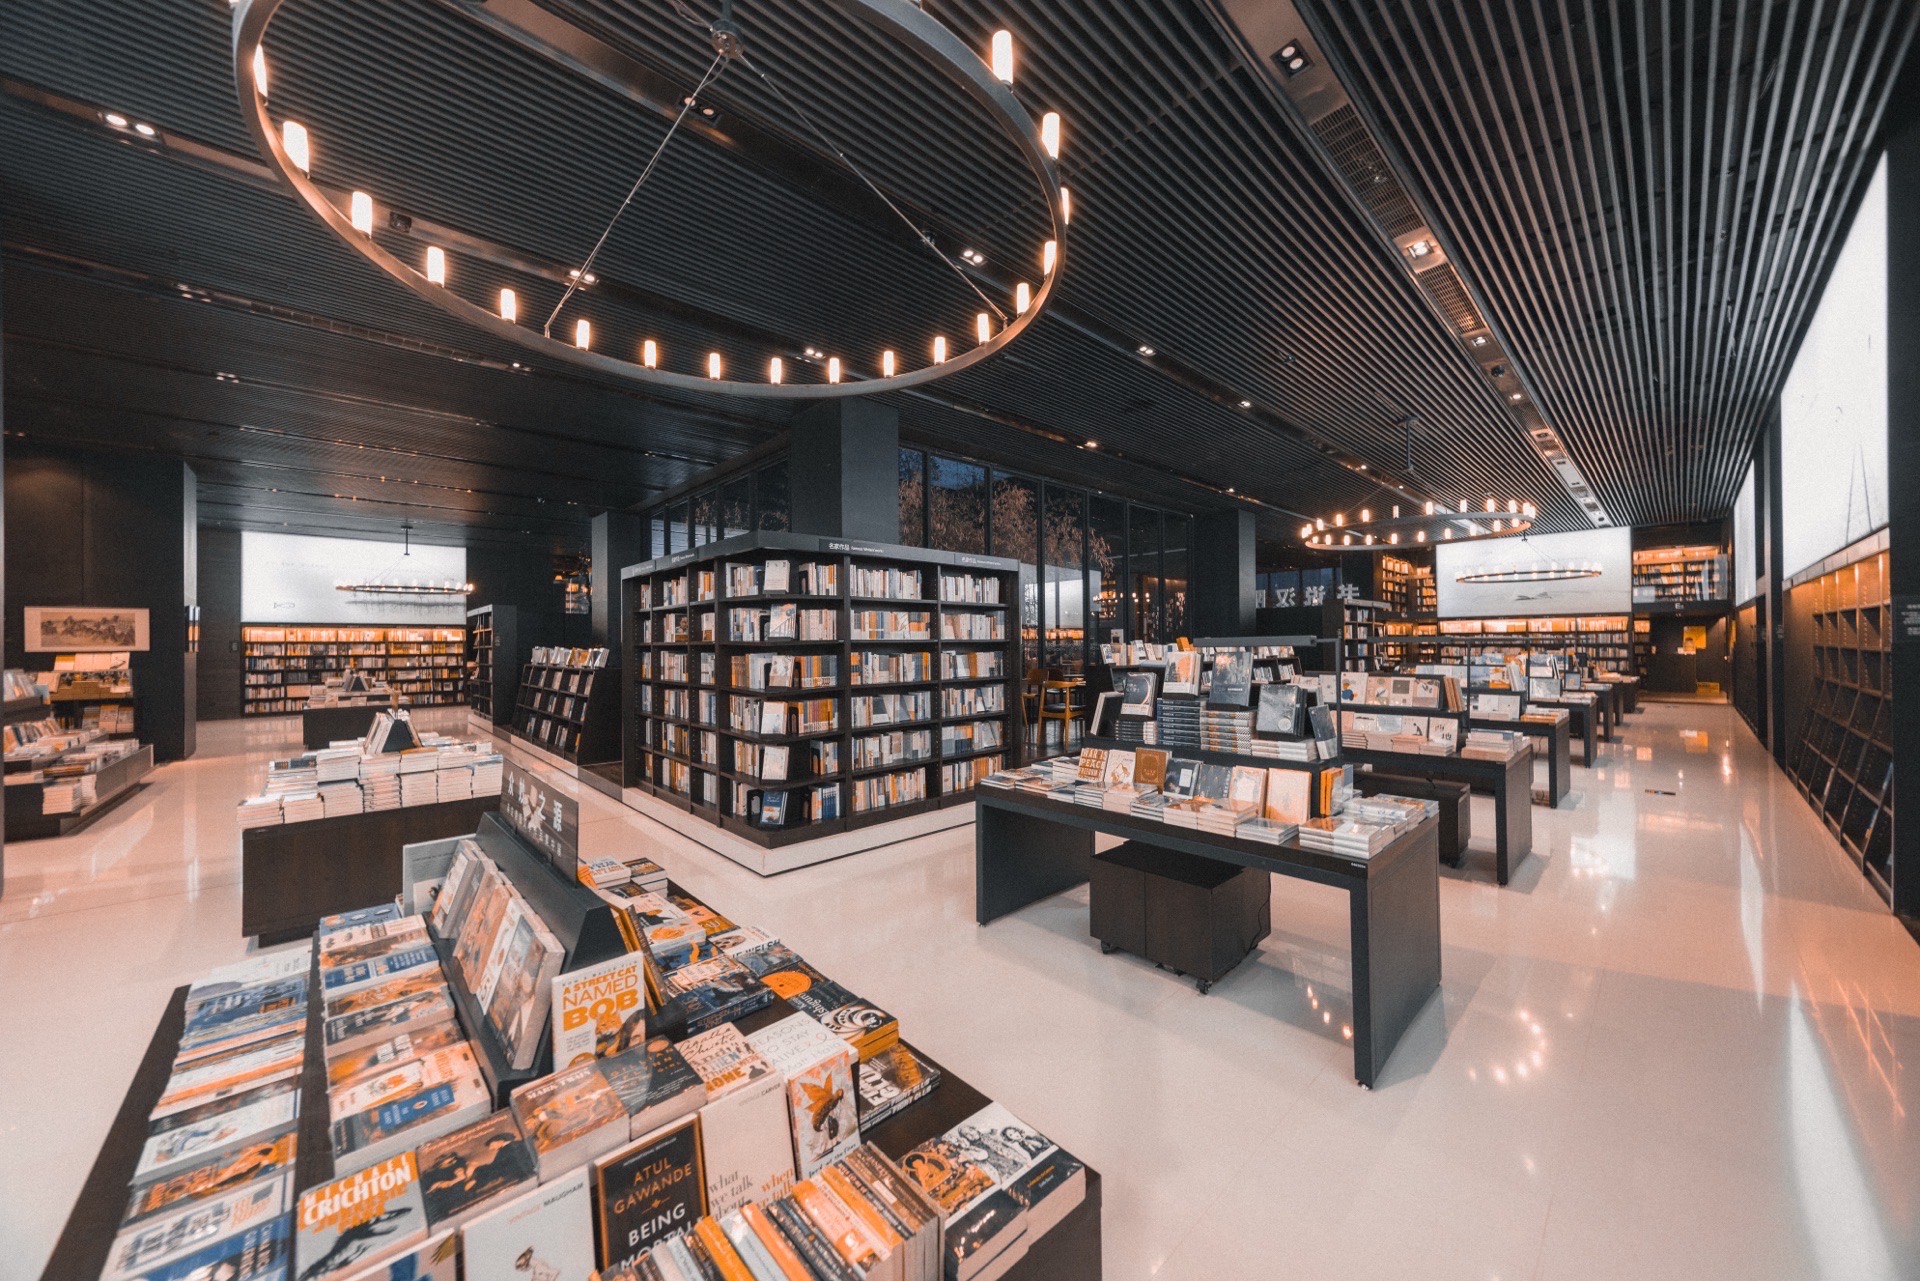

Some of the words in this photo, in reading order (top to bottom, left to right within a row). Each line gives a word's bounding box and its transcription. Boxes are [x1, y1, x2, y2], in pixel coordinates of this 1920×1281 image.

[1080, 759, 1105, 768] PEACE
[1082, 749, 1097, 759] WAR
[563, 986, 571, 995] A
[573, 972, 616, 993] STREET
[617, 965, 638, 977] CAT
[563, 974, 638, 1010] NAMED
[563, 988, 639, 1032] BOB
[679, 1028, 731, 1052] Agatha
[782, 1029, 809, 1046] STAY
[526, 1084, 558, 1100] MARK
[559, 1068, 592, 1086] TWAIN
[761, 1083, 781, 1096] CARVER
[303, 1153, 408, 1208] MICHAEL
[633, 1157, 672, 1187] ATUL
[709, 1171, 739, 1194] what
[761, 1167, 794, 1193] when
[303, 1163, 412, 1226] CRICHTON
[543, 1182, 584, 1207] MAUGHAM
[613, 1162, 693, 1214] GAWANDE
[710, 1193, 728, 1210] we
[730, 1175, 754, 1198] talk
[628, 1202, 686, 1247] BEING
